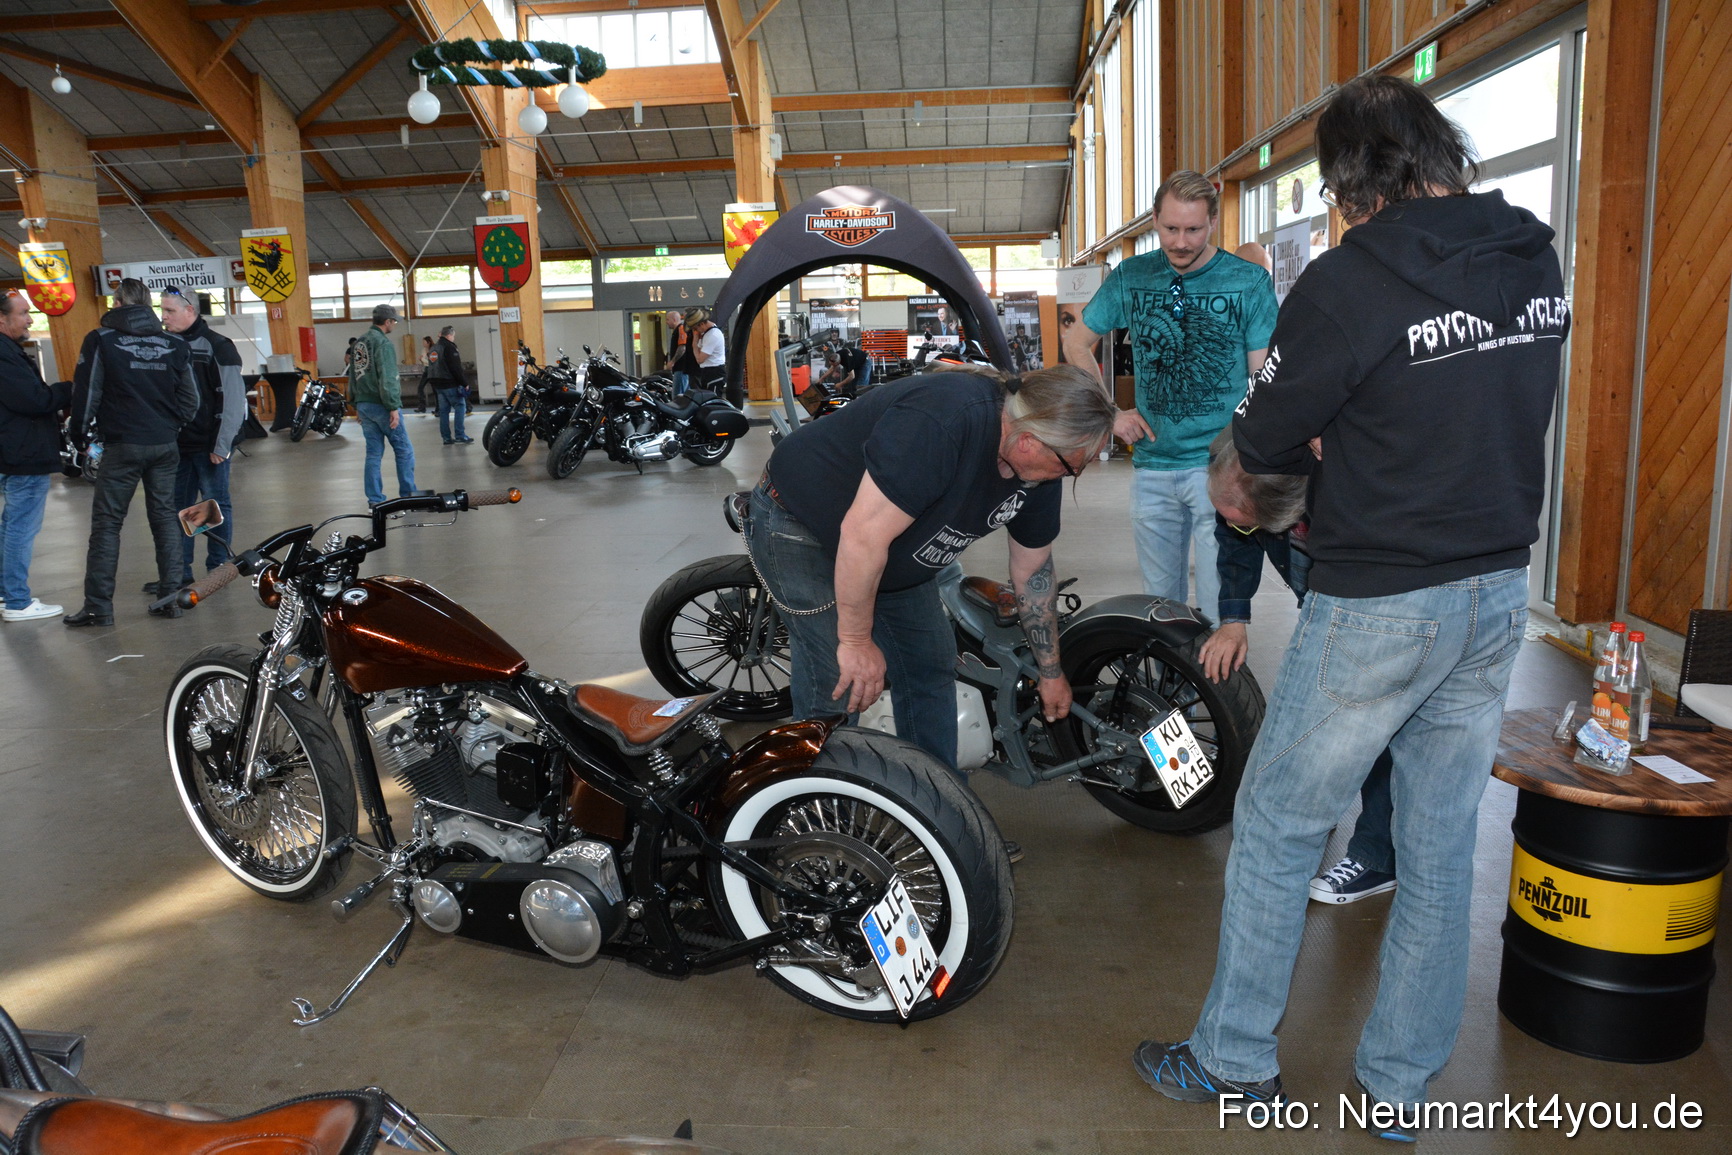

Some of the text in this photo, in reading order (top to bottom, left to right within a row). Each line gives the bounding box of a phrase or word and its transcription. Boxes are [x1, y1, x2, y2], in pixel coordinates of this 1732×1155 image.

[831, 208, 871, 217] MOTOR
[813, 216, 888, 228] HARLEY-DAVIDSON
[830, 229, 871, 243] CYCLES
[148, 262, 204, 274] Neumarkter
[1477, 333, 1535, 351] KINGS OF KUSTOMS
[920, 545, 946, 563] FUCK
[1158, 716, 1183, 746] KU
[1170, 757, 1211, 801] RK 15
[1518, 876, 1592, 919] PENNZOIL
[874, 883, 904, 937] LIF
[877, 944, 885, 958] D
[899, 947, 932, 1006] J 44
